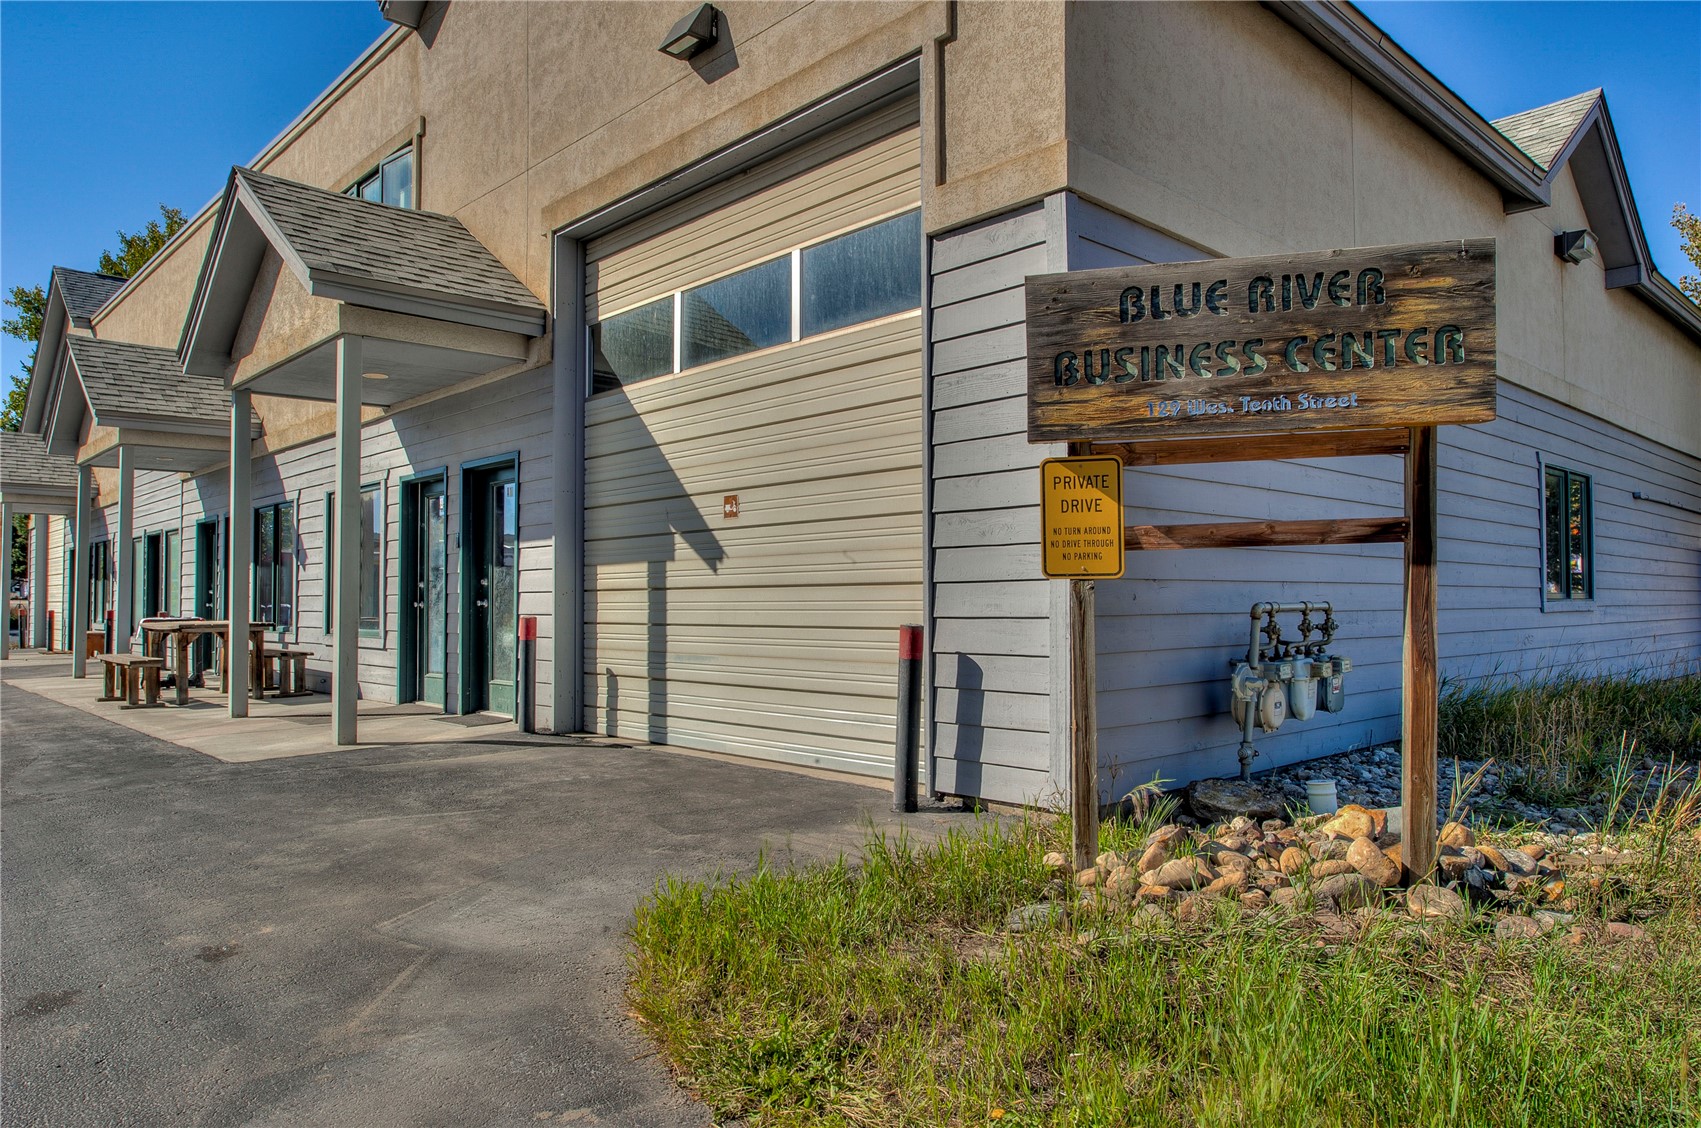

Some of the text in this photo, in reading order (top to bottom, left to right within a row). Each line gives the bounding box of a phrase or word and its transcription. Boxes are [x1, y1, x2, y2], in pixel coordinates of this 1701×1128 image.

[1119, 266, 1387, 324] BLUE RIVER
[1053, 323, 1467, 387] BUSINESS CENTER
[1148, 401, 1181, 417] 129
[1239, 394, 1292, 413] Tenth
[1297, 392, 1359, 411] Street
[1053, 474, 1109, 490] PRIVATE
[1061, 498, 1102, 513] DRIVE
[1052, 526, 1112, 536] NO TURN AROUND
[1050, 539, 1114, 548] NO DRIVE THROUGH
[1062, 552, 1103, 561] NO PARKING
